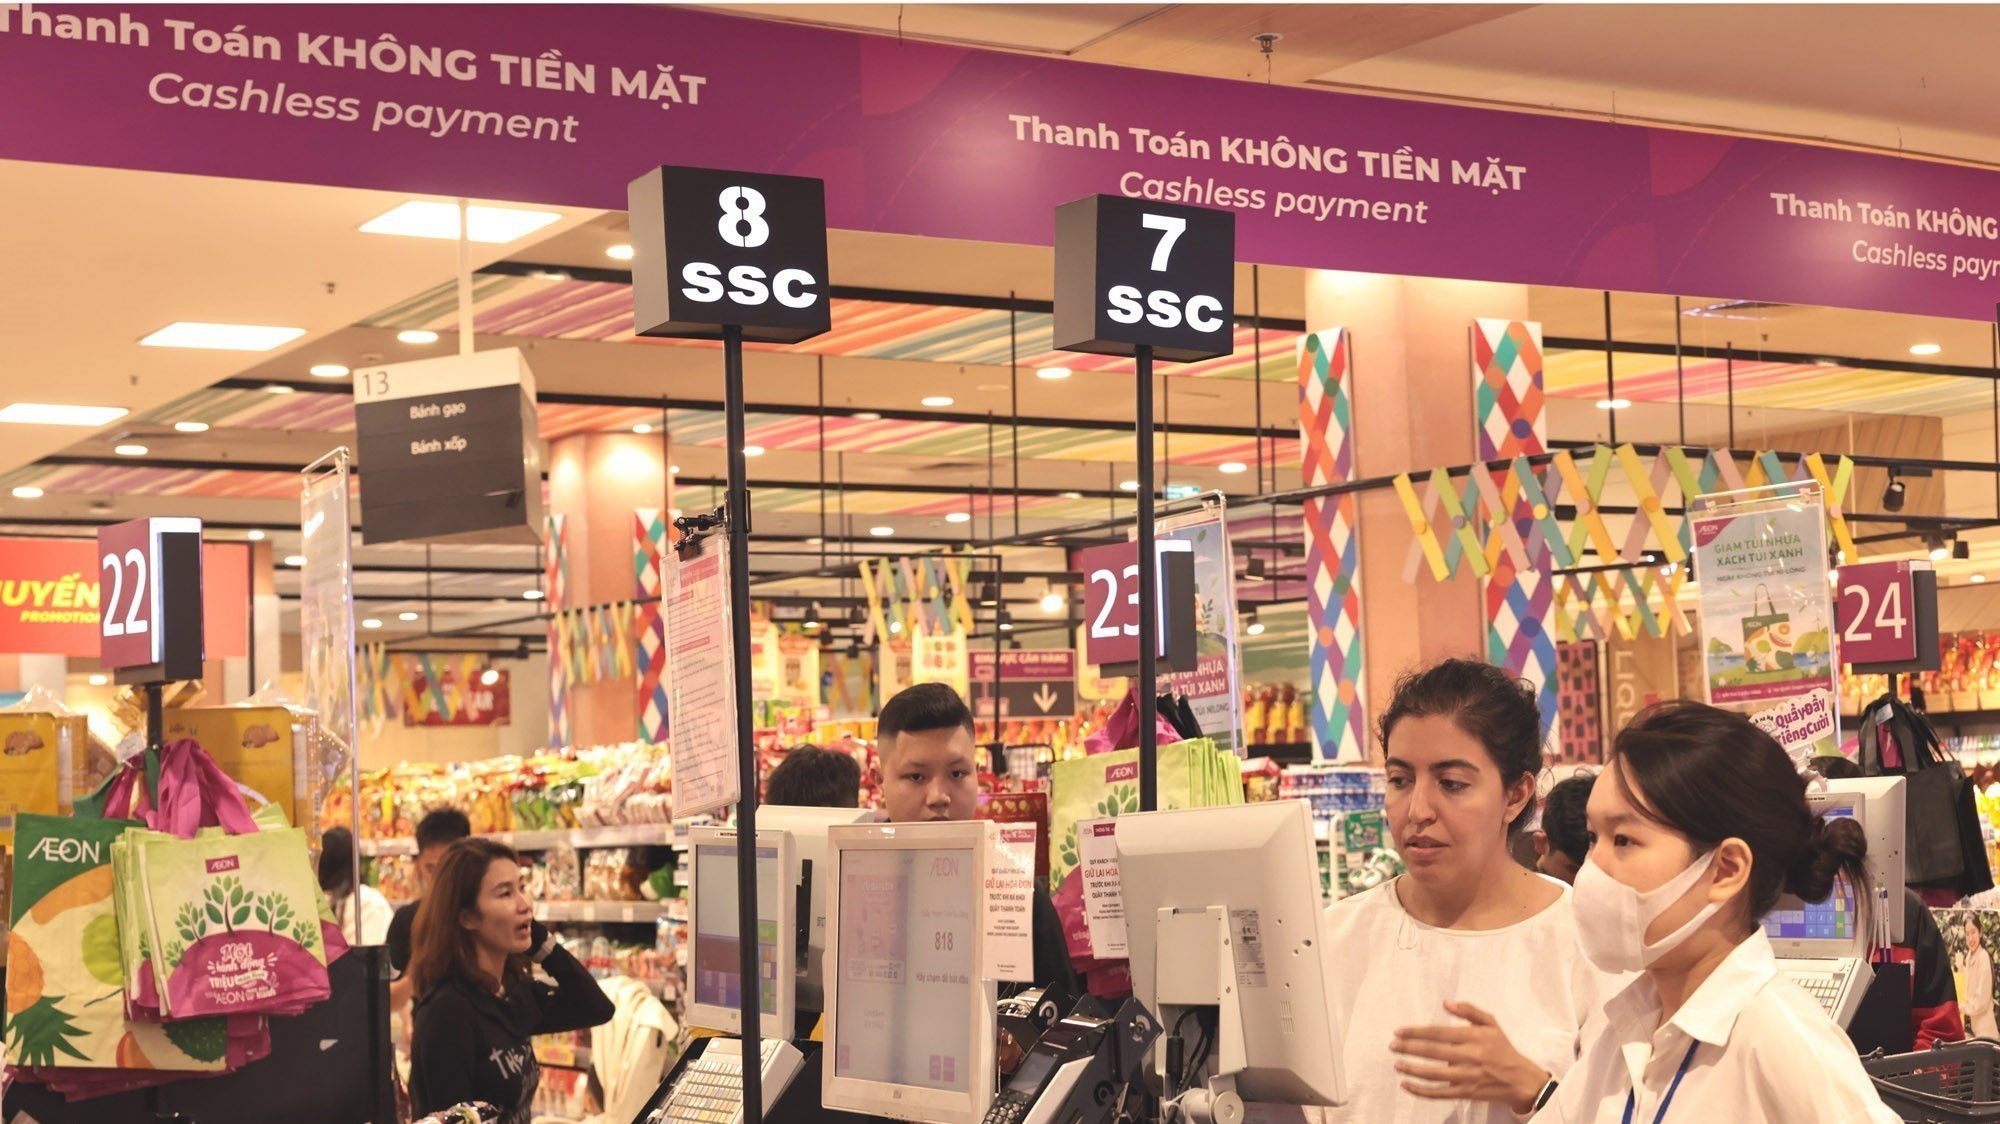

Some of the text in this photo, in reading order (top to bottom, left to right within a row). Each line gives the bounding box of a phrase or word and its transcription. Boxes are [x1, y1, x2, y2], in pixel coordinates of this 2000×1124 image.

[165, 19, 281, 60] Toán
[298, 33, 477, 82] KHÔNG
[491, 48, 595, 93] TIỀN
[611, 63, 706, 110] MẶT
[148, 72, 578, 142] Cashless payment
[1009, 115, 1526, 195] Thanh Toán KHÔNG TIỀN MẶT
[718, 186, 769, 248] 8
[1119, 171, 1428, 224] Cashless payment
[1770, 192, 1998, 240] Thanh Toán KHÔNG
[1142, 213, 1187, 272] 7
[1852, 240, 1947, 271] Cashless
[681, 262, 818, 308] SSC
[1107, 285, 1223, 333] SSC
[362, 371, 389, 396] 13
[410, 403, 440, 419] Bánh
[411, 439, 441, 455] Bánh
[0, 572, 100, 608] UYẾN
[102, 548, 148, 637] 22
[1844, 582, 1907, 643] 24
[1197, 678, 1226, 696] XANH
[935, 931, 954, 951] 818
